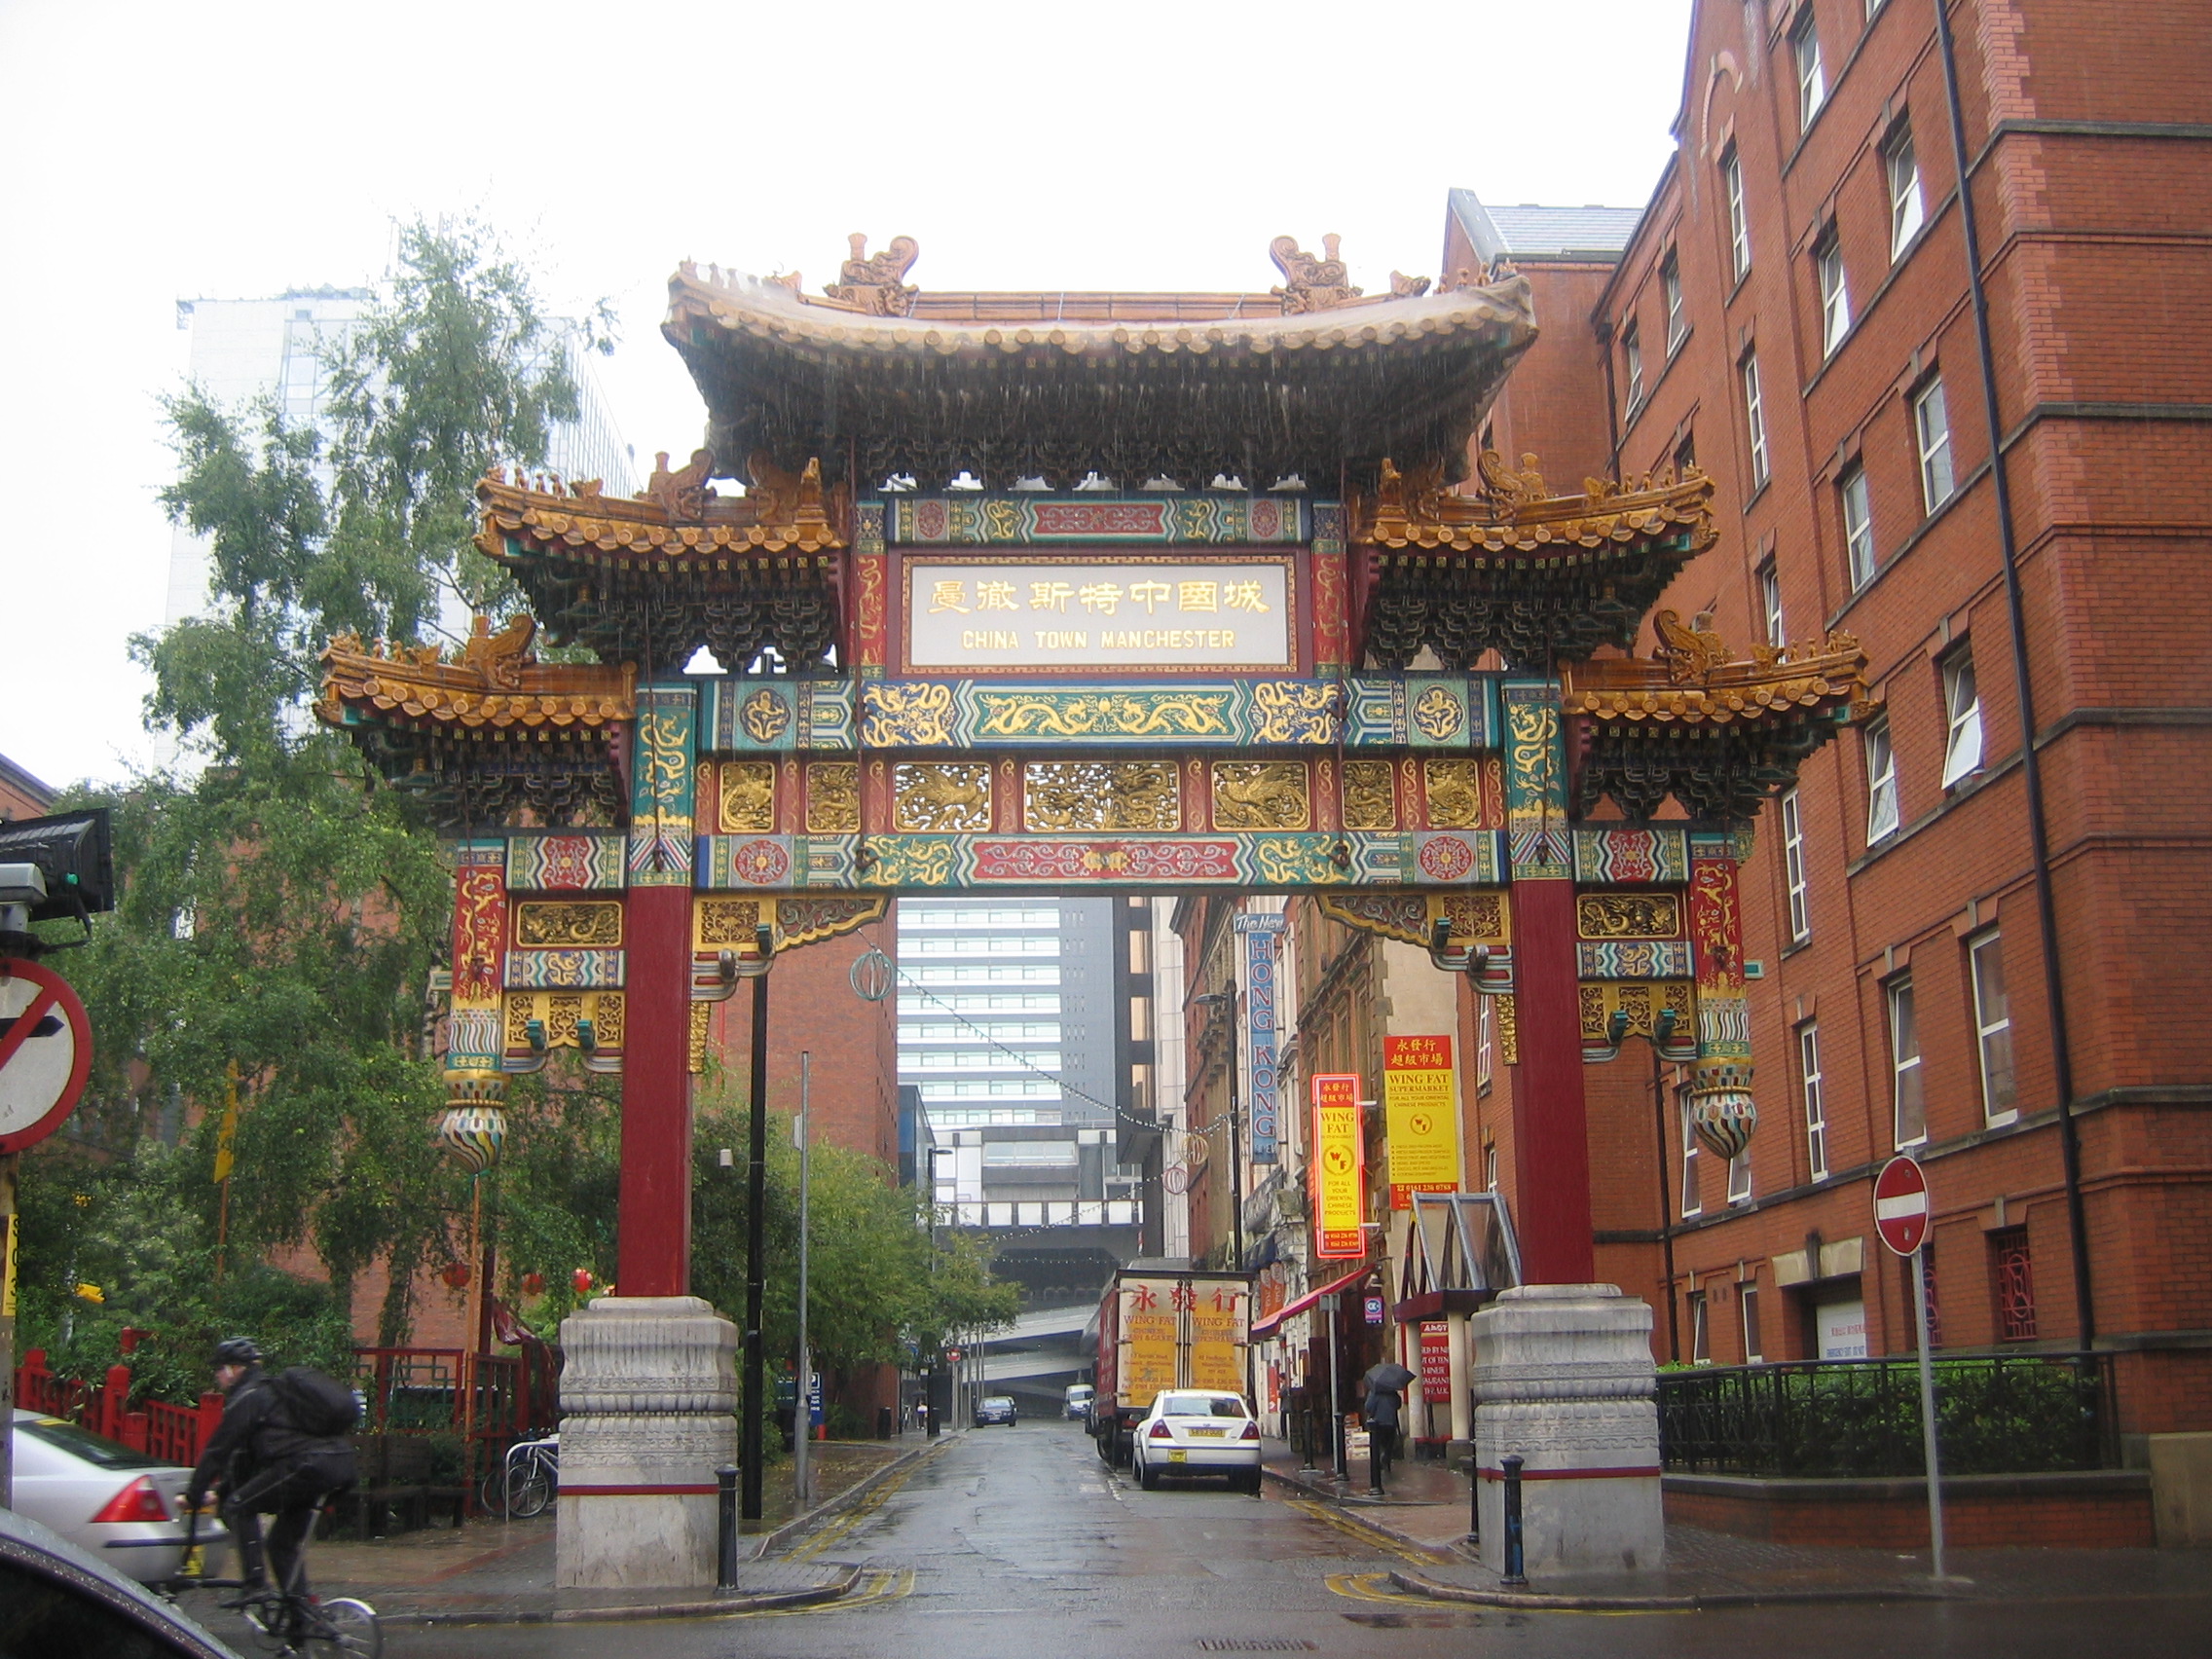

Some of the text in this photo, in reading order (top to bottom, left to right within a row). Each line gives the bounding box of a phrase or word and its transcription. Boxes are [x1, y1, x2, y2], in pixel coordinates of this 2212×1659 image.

[928, 578, 1271, 615] 曼徹斯特中國城
[962, 628, 1235, 649] CHINA TOWN MANCHESTER
[1236, 914, 1258, 930] The
[1250, 939, 1274, 1031] HONG
[1389, 1074, 1449, 1085] WING FAT
[1253, 1044, 1276, 1137] KONG
[1320, 1112, 1354, 1133] WING FAT
[1124, 1314, 1176, 1326] WING FAT
[1192, 1316, 1245, 1327] WING FAT
